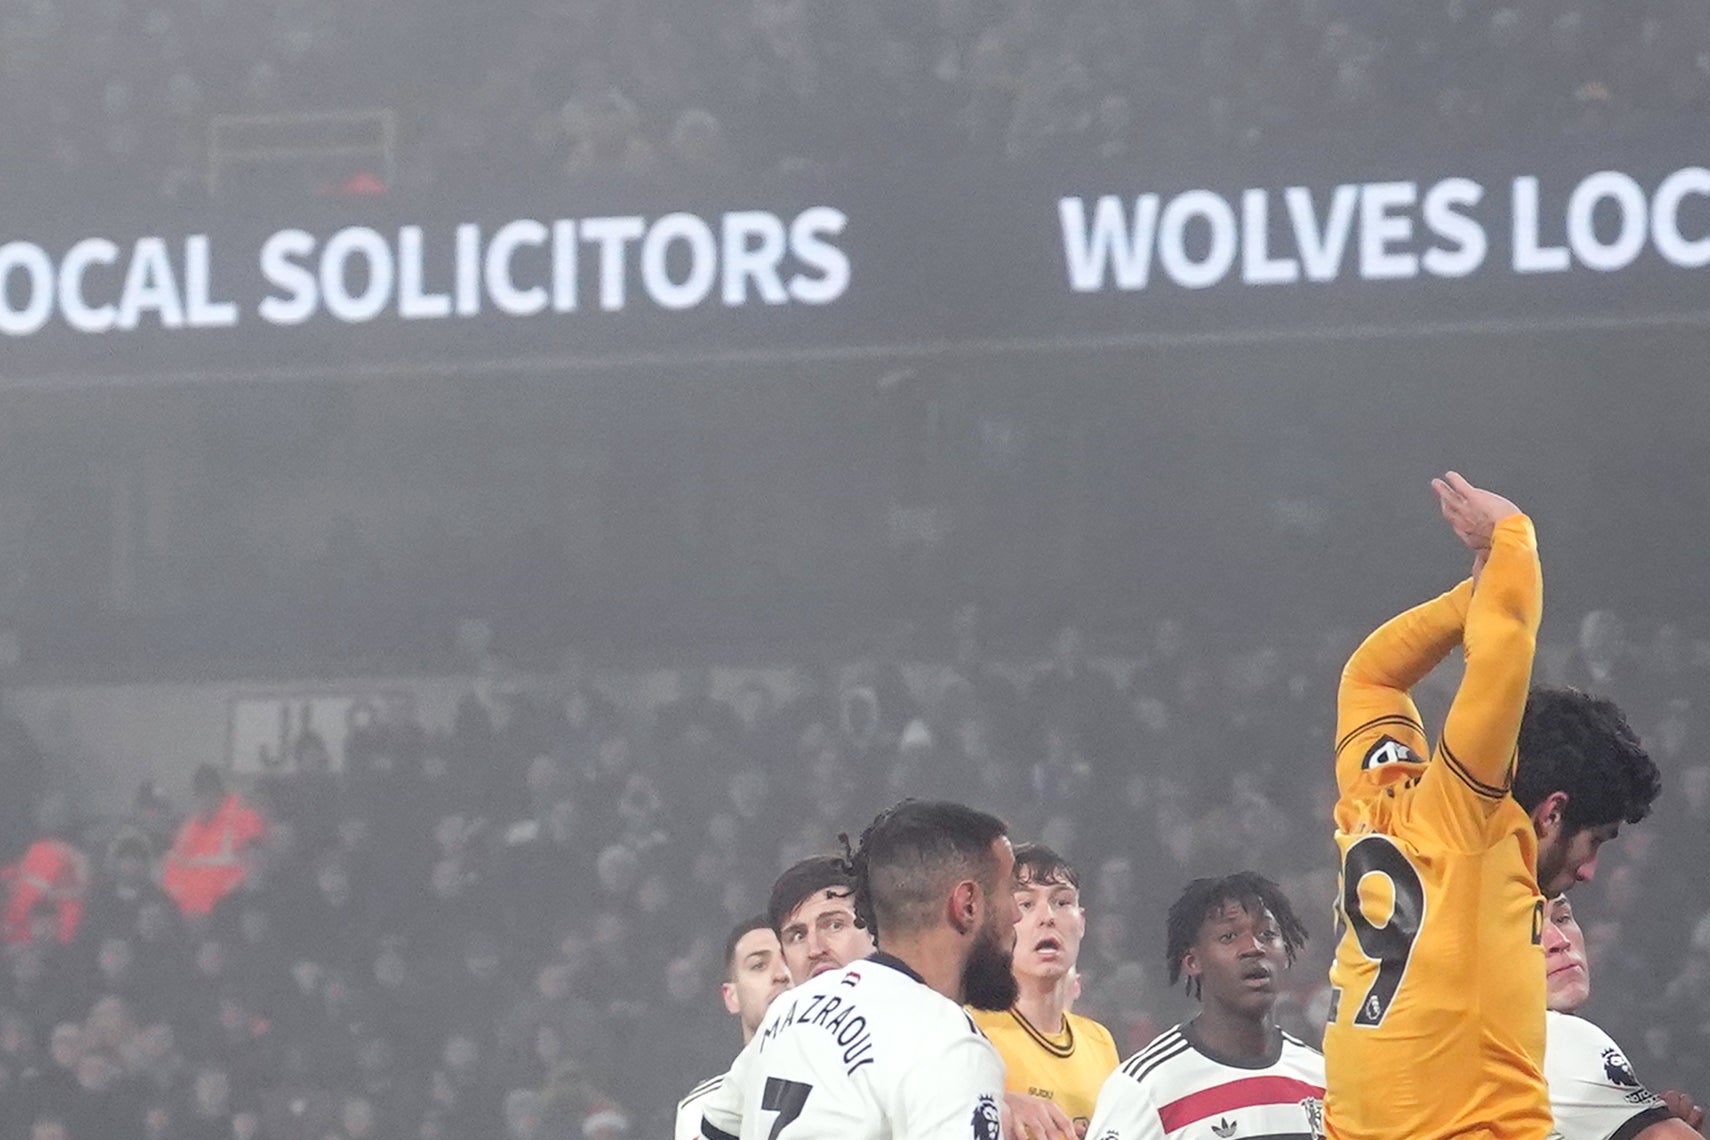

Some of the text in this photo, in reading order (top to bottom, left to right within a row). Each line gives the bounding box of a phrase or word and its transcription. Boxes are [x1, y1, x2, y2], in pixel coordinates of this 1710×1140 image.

[0, 205, 852, 336] OCAL SOLICITORS
[1058, 176, 1487, 292] WOLVES
[1327, 832, 1428, 1028] 9
[759, 994, 875, 1077] MAZRAOUI
